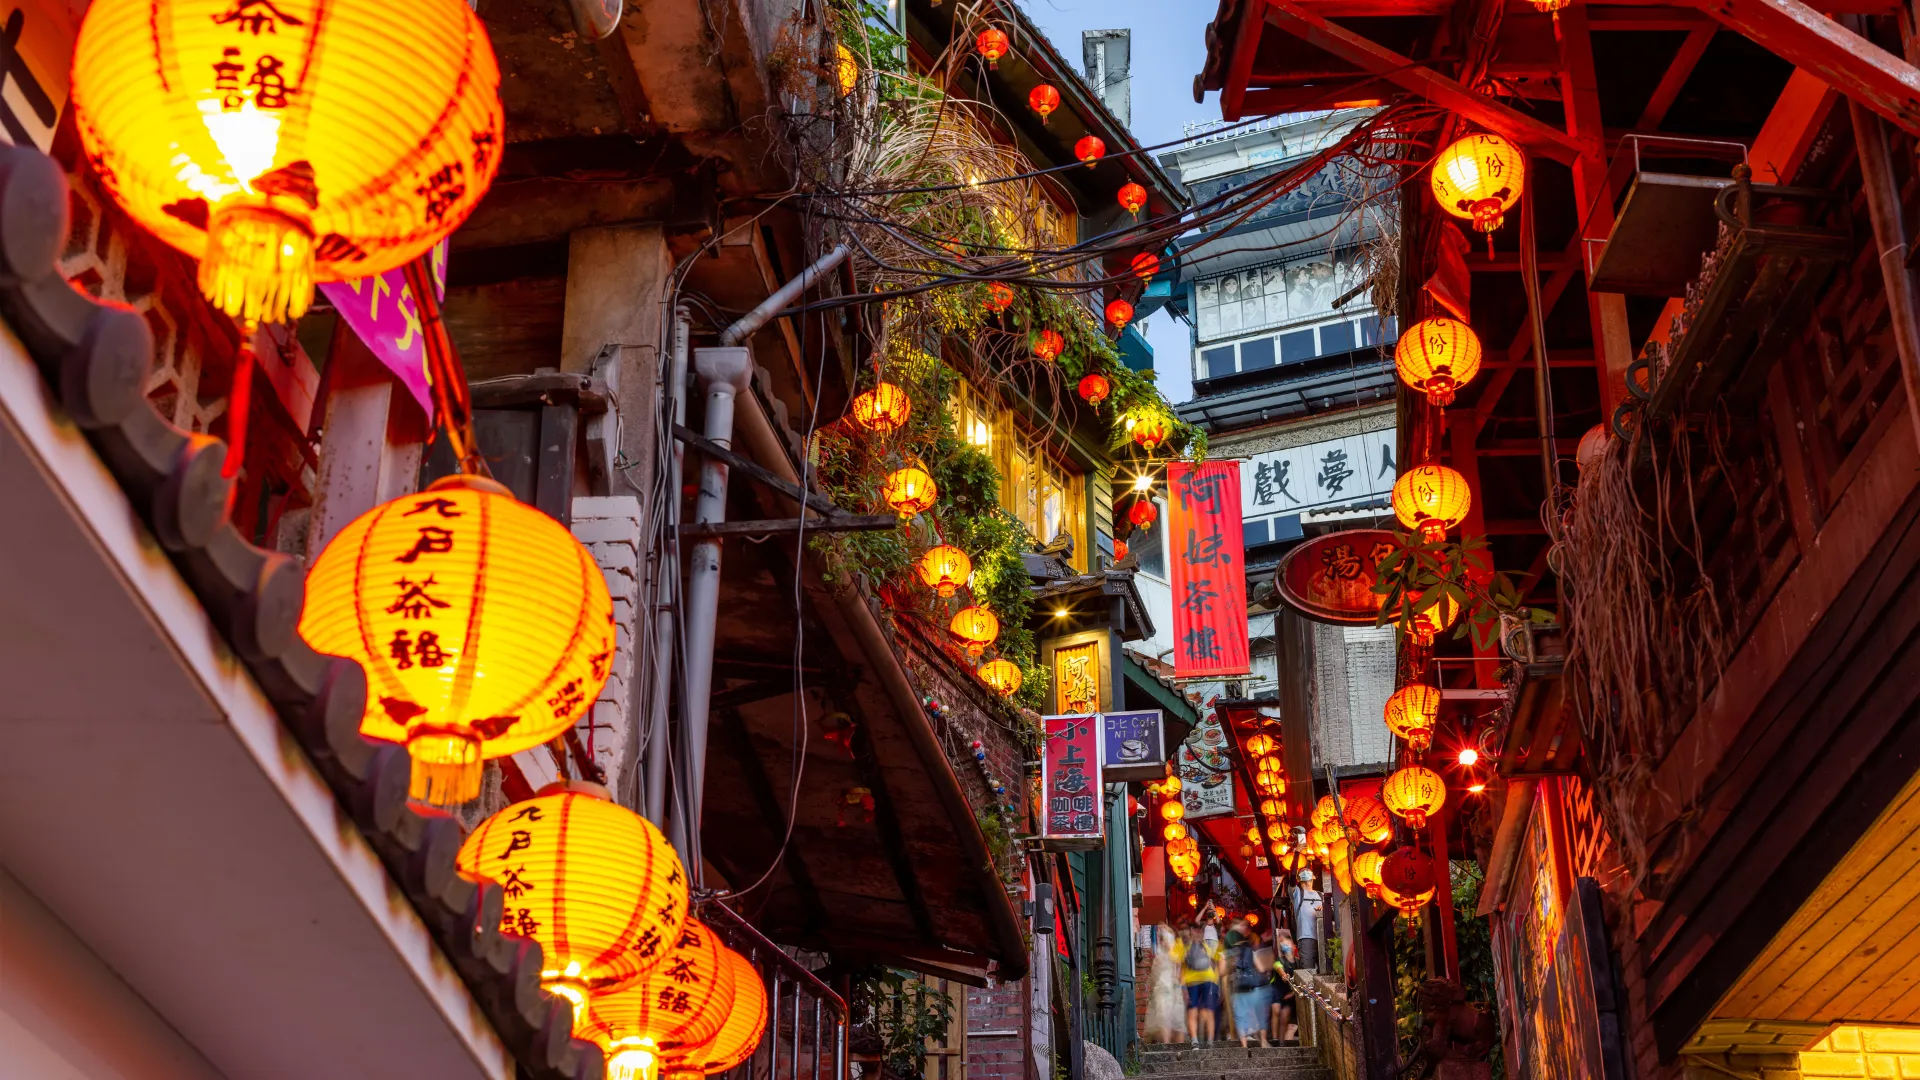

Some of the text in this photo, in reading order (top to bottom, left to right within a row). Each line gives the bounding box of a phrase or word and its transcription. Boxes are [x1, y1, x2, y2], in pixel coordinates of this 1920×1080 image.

[1177, 471, 1231, 661] 阿妹茶樓
[1054, 721, 1091, 793] 小上海
[1051, 796, 1093, 813] 咖啡
[1051, 814, 1094, 831] 茶樓
